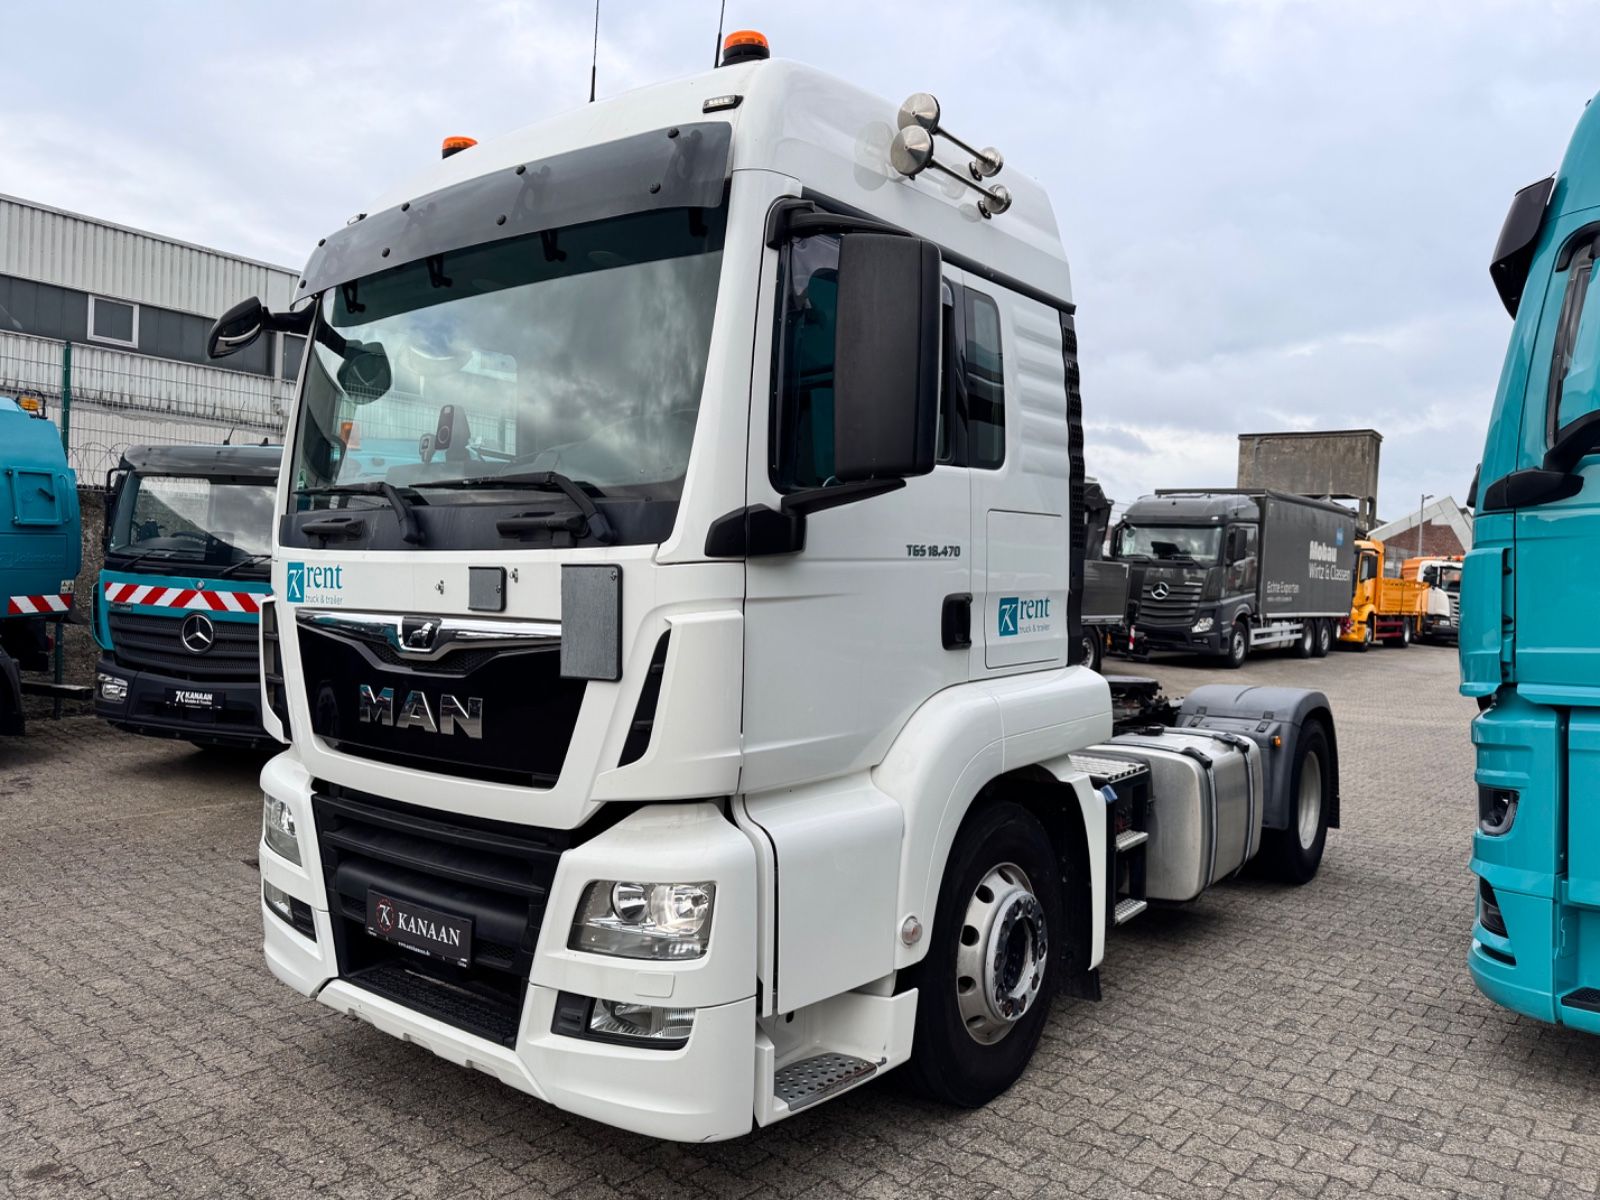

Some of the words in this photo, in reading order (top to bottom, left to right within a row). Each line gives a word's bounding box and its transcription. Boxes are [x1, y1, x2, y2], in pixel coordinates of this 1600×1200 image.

[906, 544, 926, 557] TGS
[927, 545, 961, 557] 18.470
[306, 564, 343, 590] rent
[1020, 597, 1050, 620] rent
[185, 691, 213, 701] KANAAN
[359, 683, 483, 739] MAN
[397, 912, 461, 947] KANAAN
